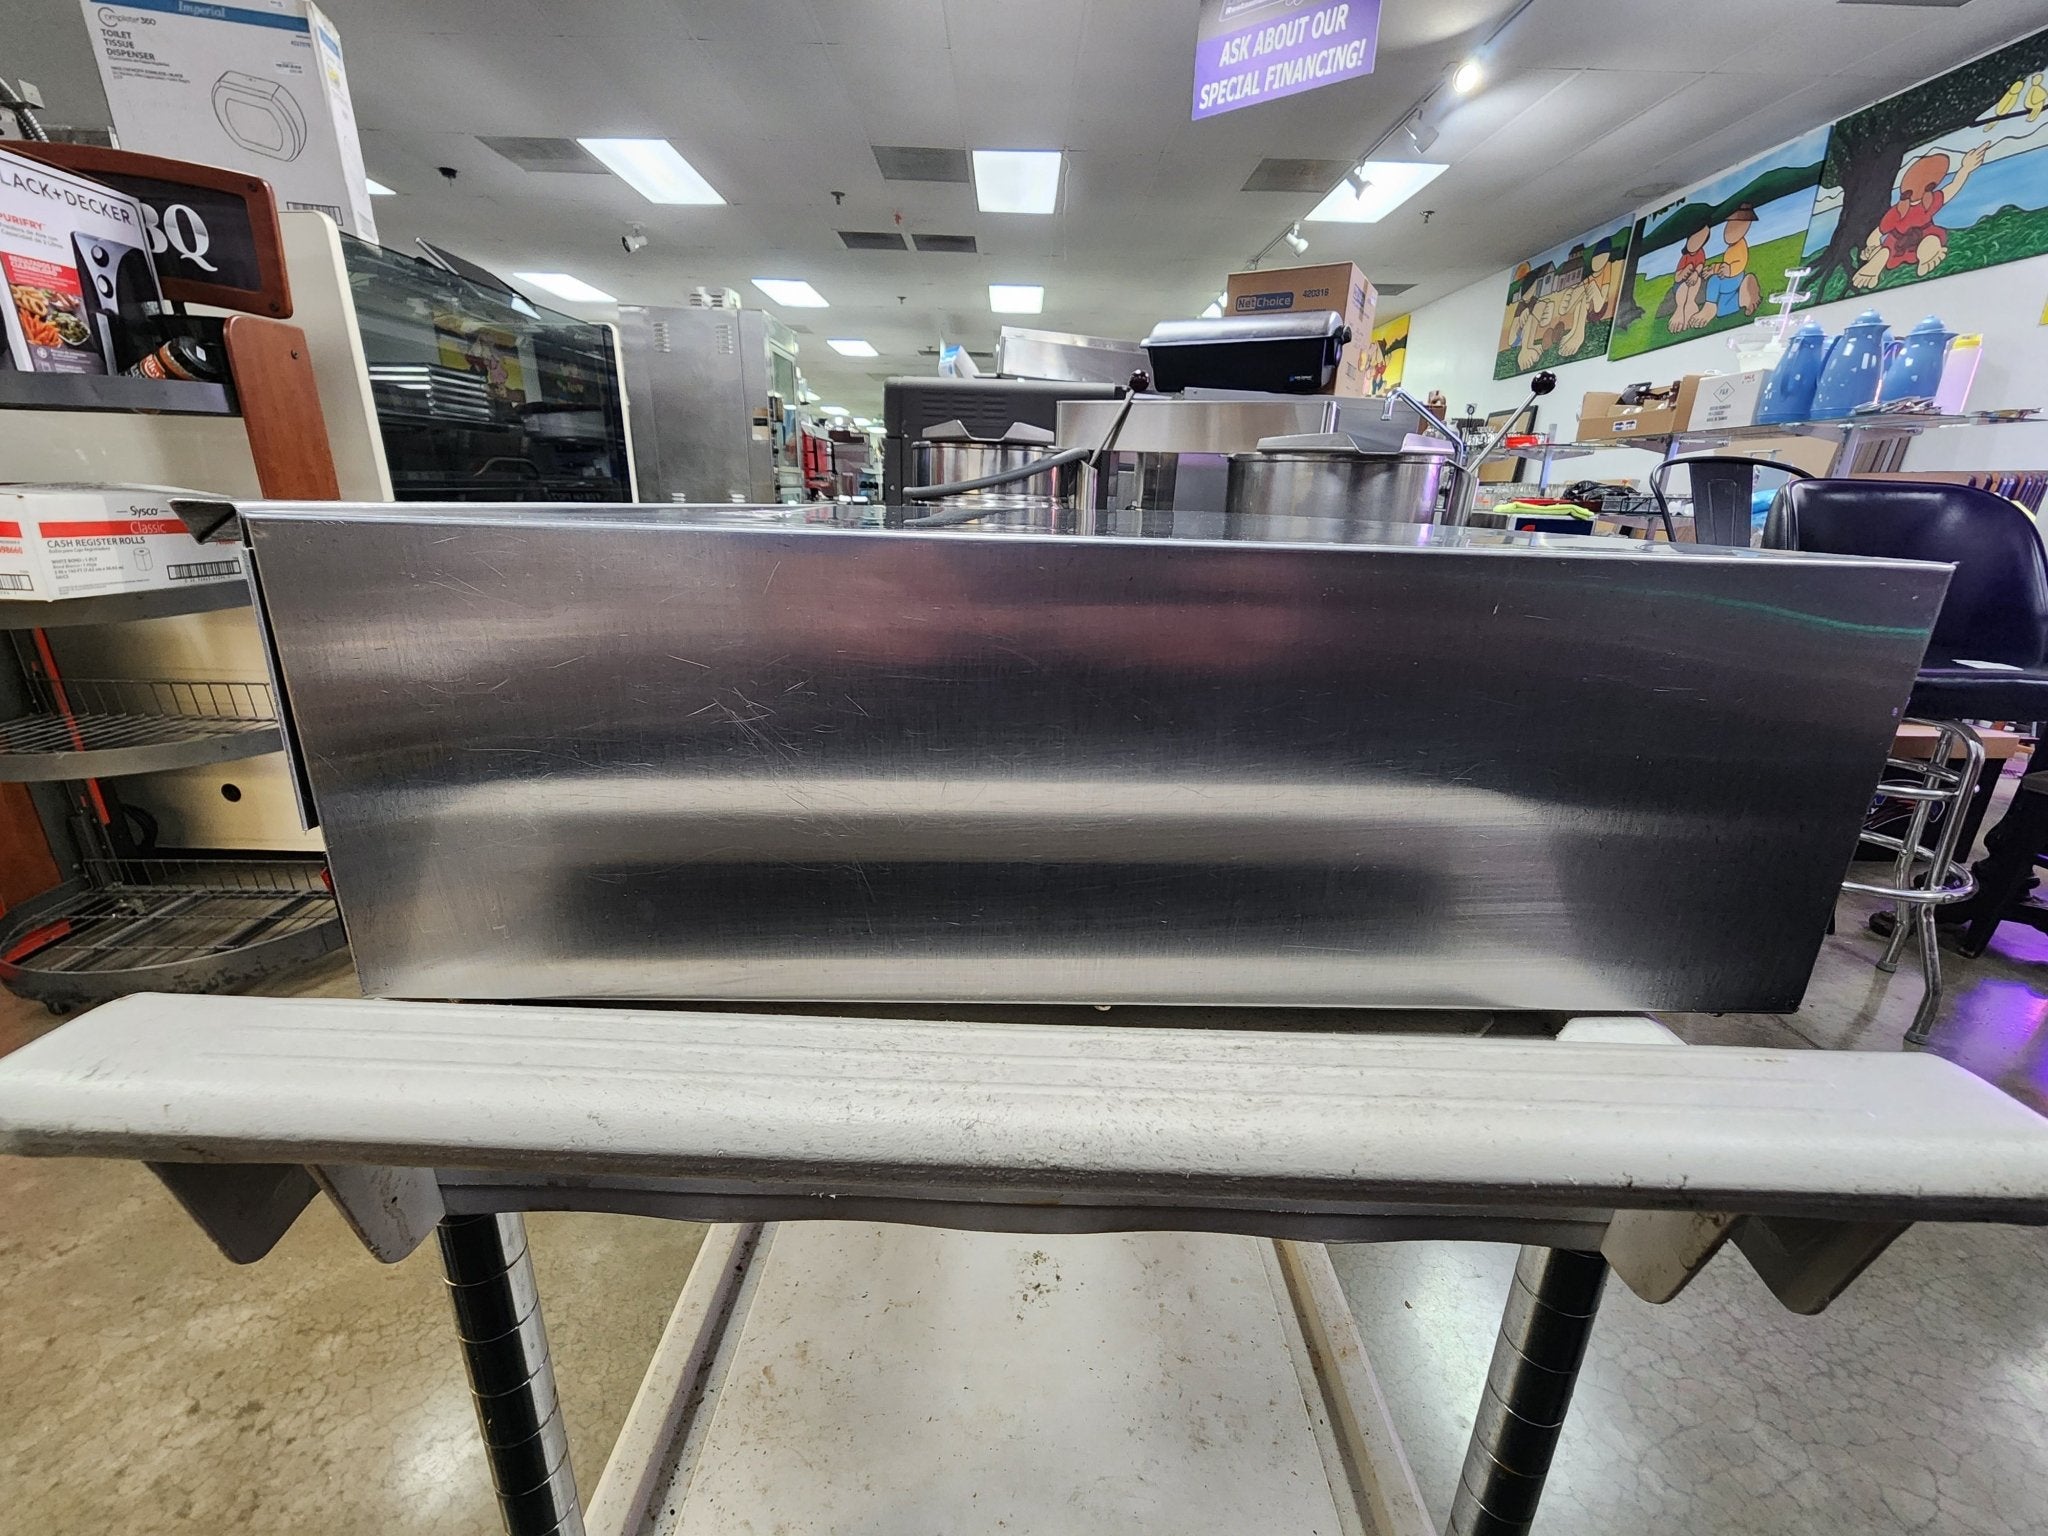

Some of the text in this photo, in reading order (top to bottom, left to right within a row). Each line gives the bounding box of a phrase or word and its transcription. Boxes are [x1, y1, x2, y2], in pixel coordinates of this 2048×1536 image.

[178, 1, 226, 18] Imperial
[101, 28, 132, 39] TOILET
[1219, 34, 1252, 67] ASK
[1252, 15, 1310, 57] ABOUT
[1311, 4, 1349, 39] OUR
[103, 38, 134, 49] TISSUE
[106, 47, 155, 60] DISPENSER
[1199, 38, 1367, 109] SPECIAL FINANCING!
[130, 505, 158, 518] Sysco
[130, 521, 167, 534] Classic
[47, 536, 146, 549] CASH REGISTER ROLLS
